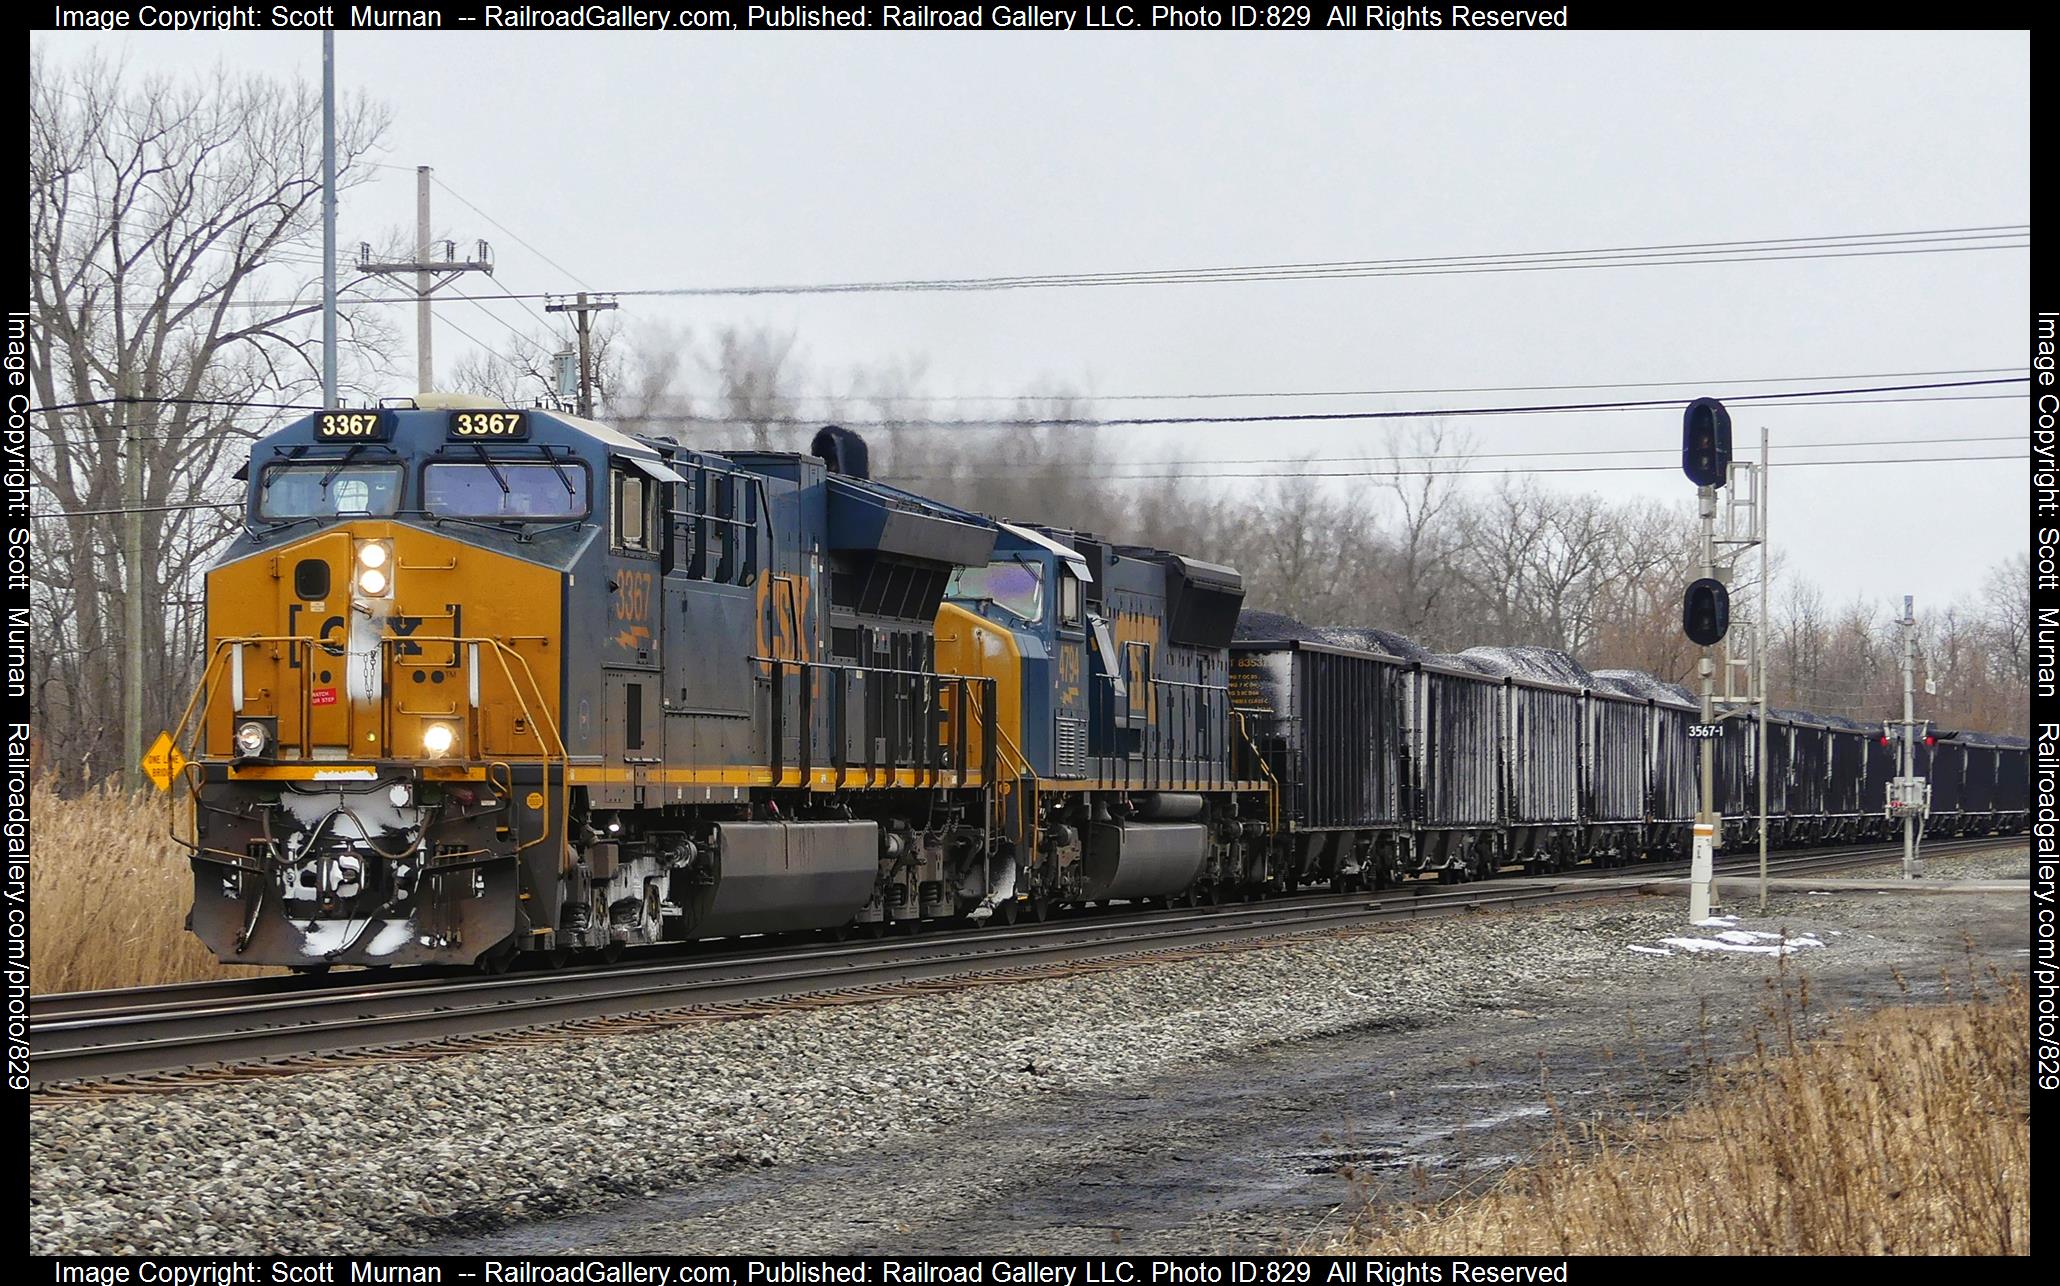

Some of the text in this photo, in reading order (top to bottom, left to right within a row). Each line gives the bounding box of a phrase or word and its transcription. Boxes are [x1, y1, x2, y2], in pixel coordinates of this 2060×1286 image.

[322, 414, 377, 436] 3367
[458, 413, 520, 435] 3367
[616, 568, 653, 621] 3367
[1059, 644, 1080, 683] 4794
[1238, 658, 1273, 668] 8353
[321, 696, 336, 704] STEP
[1688, 725, 1724, 737] 3567-1
[149, 755, 179, 764] ONE LNE
